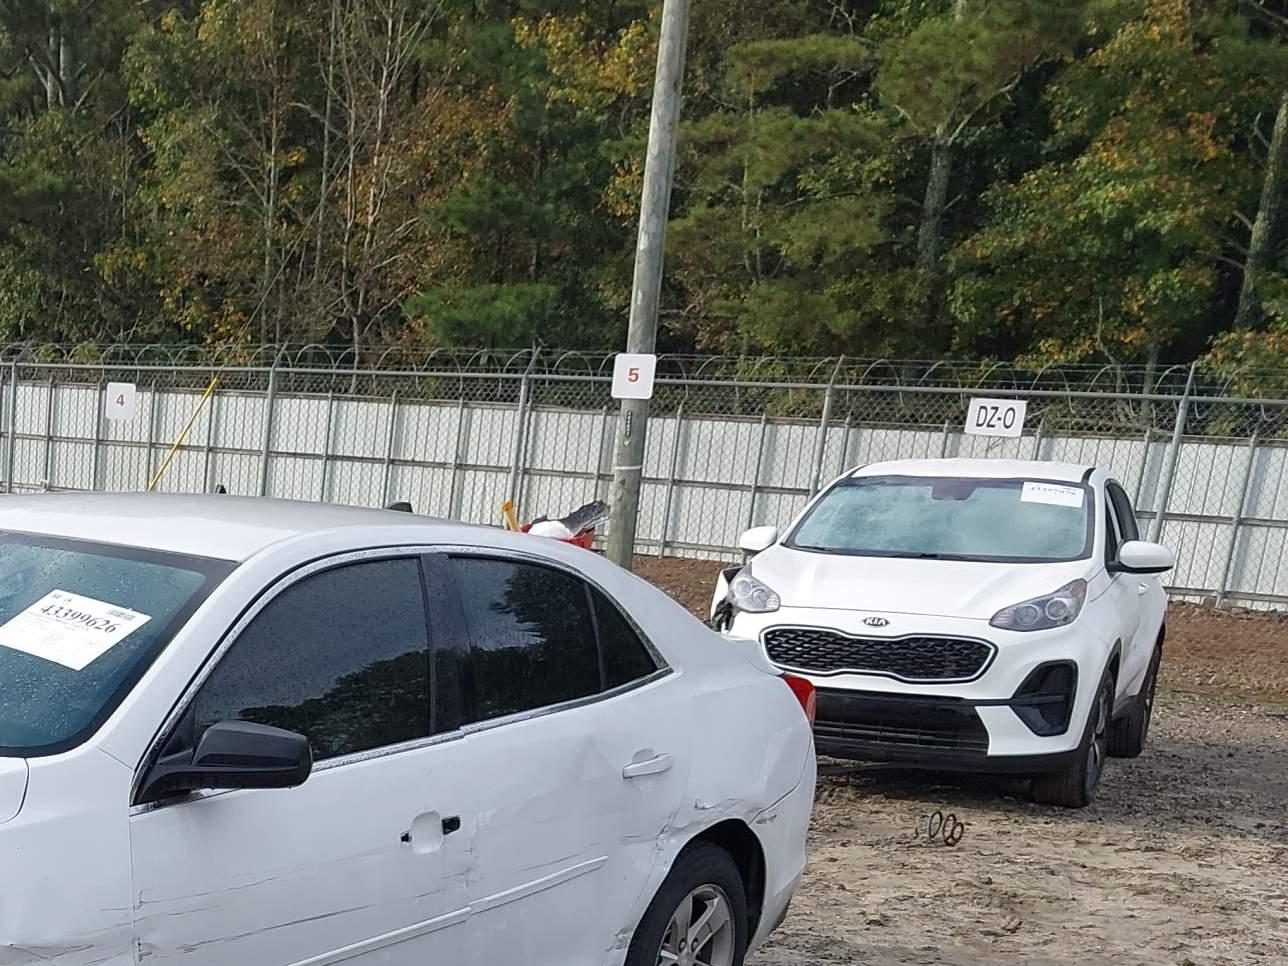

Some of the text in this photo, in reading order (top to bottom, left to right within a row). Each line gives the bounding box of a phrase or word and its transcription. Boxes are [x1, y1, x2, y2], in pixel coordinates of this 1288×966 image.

[628, 368, 640, 382] 5
[116, 394, 125, 407] 4
[40, 604, 121, 633] 43399626
[865, 617, 887, 626] KIA
